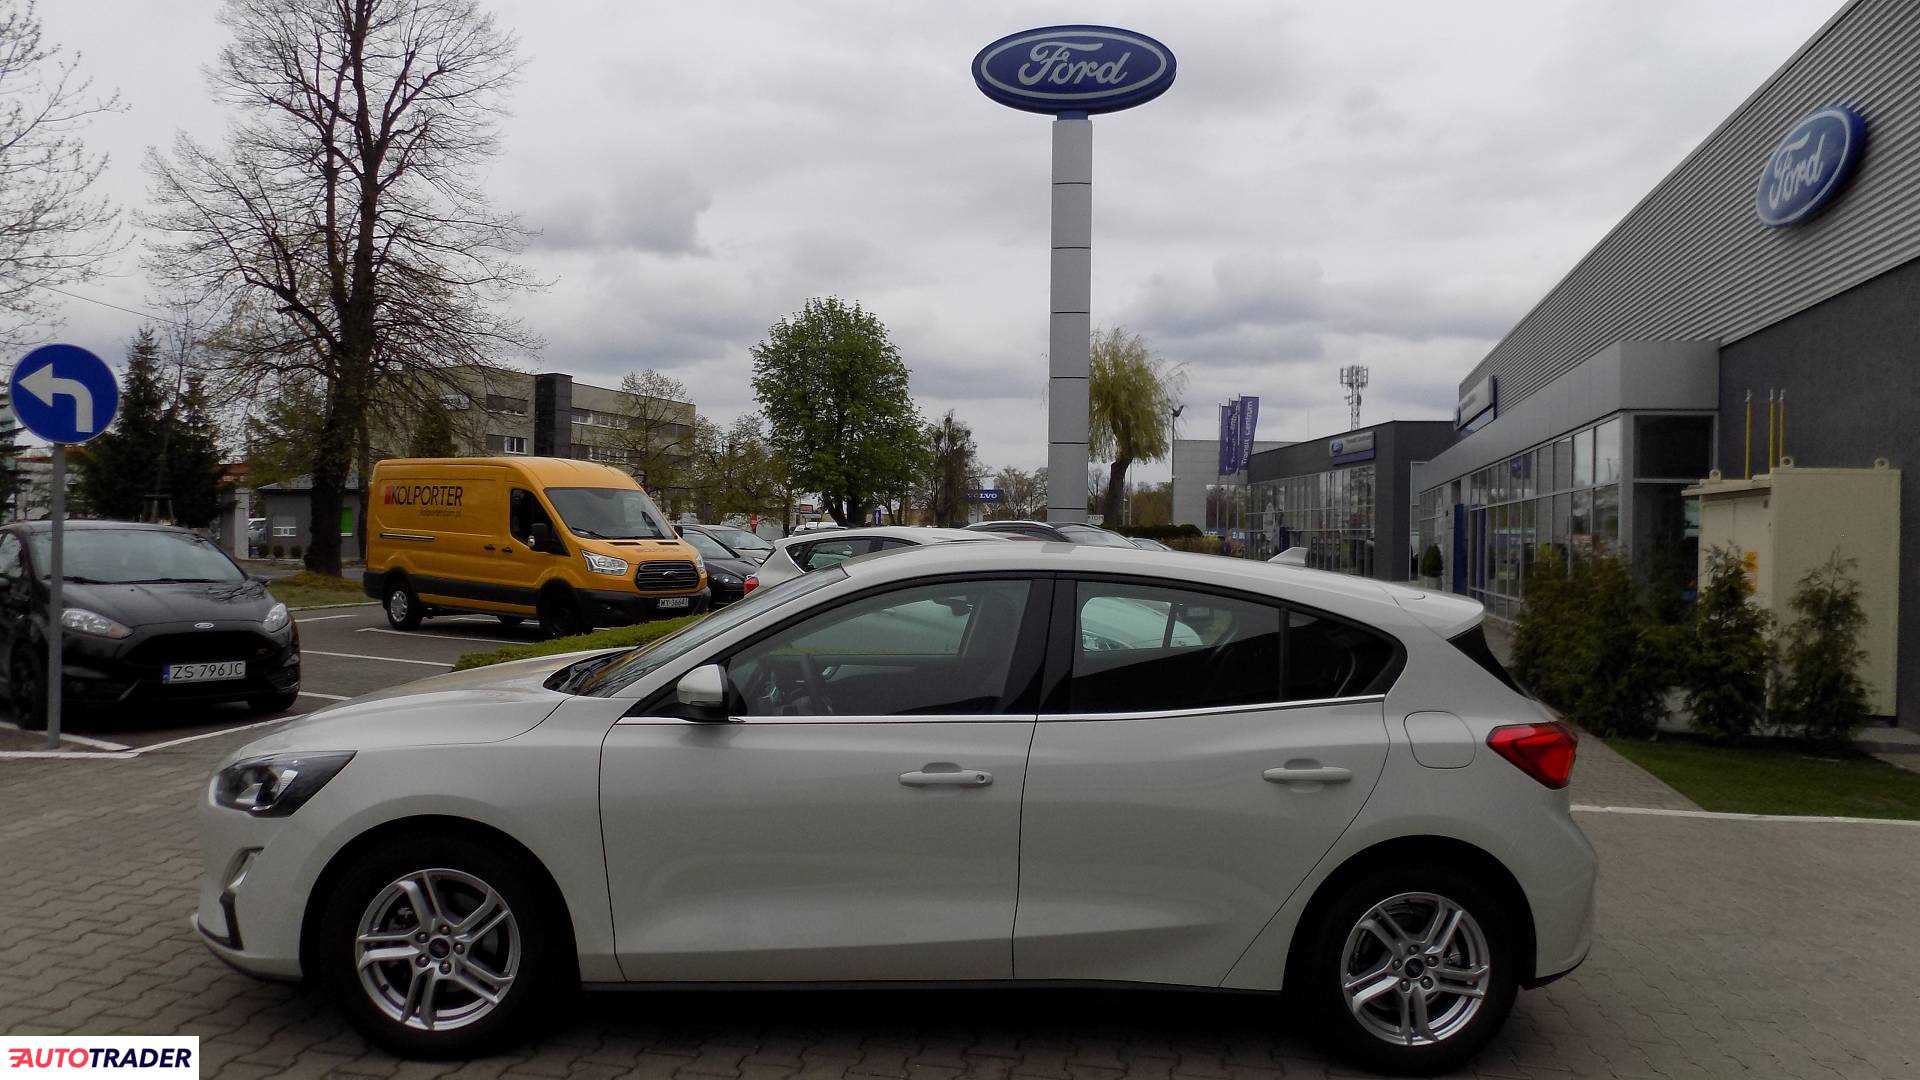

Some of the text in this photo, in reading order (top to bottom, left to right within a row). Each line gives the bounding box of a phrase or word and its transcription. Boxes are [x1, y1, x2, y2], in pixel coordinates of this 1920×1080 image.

[1018, 41, 1131, 86] Ford
[1769, 131, 1826, 210] Ford
[391, 485, 464, 506] KOLPORTER
[173, 662, 244, 679] ZS 796JC
